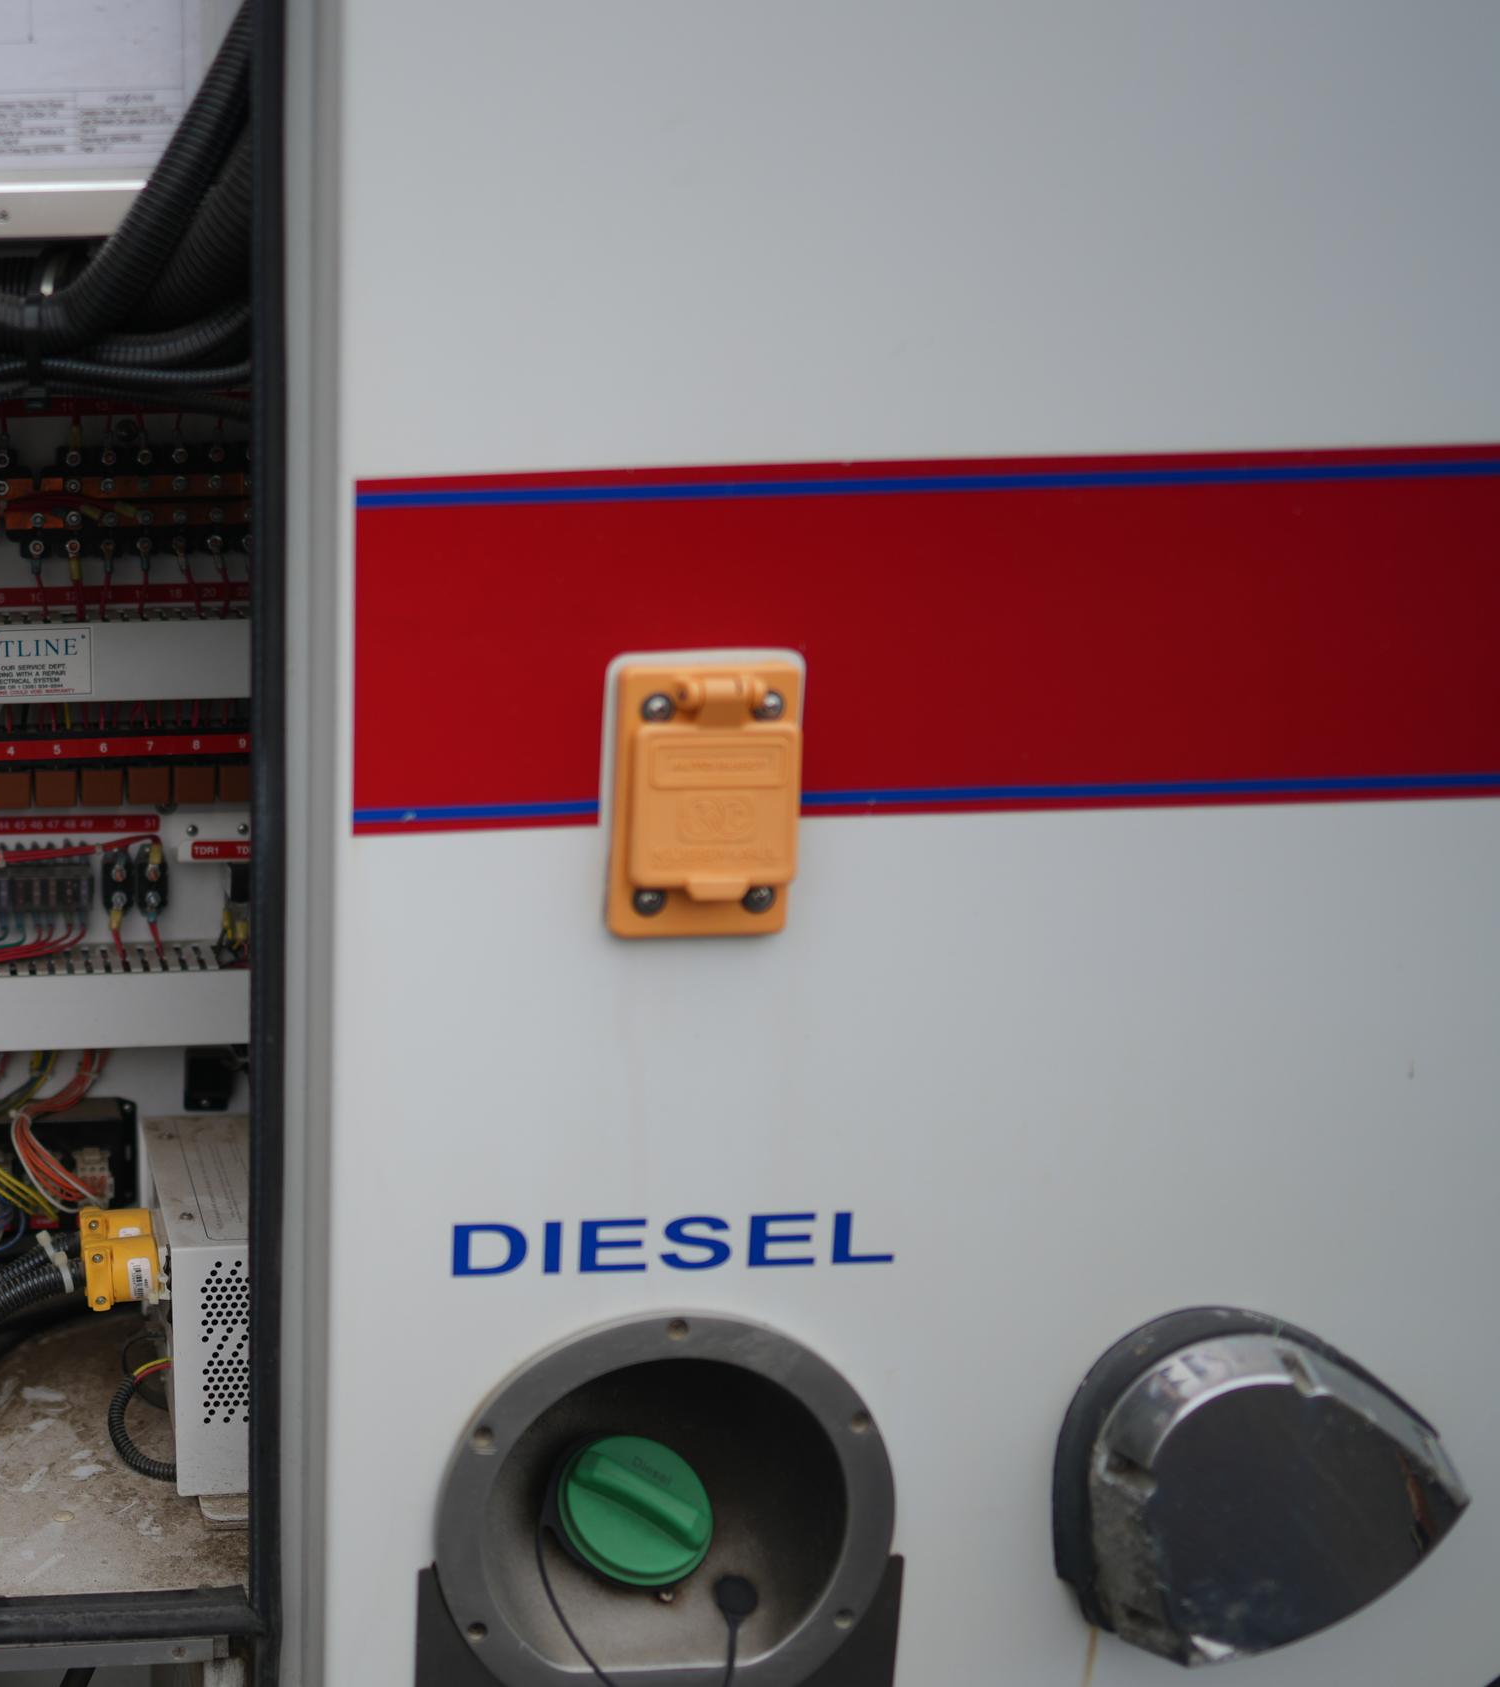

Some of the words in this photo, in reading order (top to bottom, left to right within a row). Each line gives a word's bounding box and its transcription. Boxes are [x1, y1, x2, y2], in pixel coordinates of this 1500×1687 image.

[6, 746, 15, 757] 4
[53, 744, 61, 755] 5
[100, 742, 108, 753] 6
[146, 741, 154, 751] 7
[192, 740, 201, 750] 8
[238, 738, 247, 749] 9
[195, 846, 219, 856] TDR1
[235, 846, 251, 856] TD
[452, 1211, 894, 1276] DIESEL
[631, 1455, 673, 1486] Diesel
